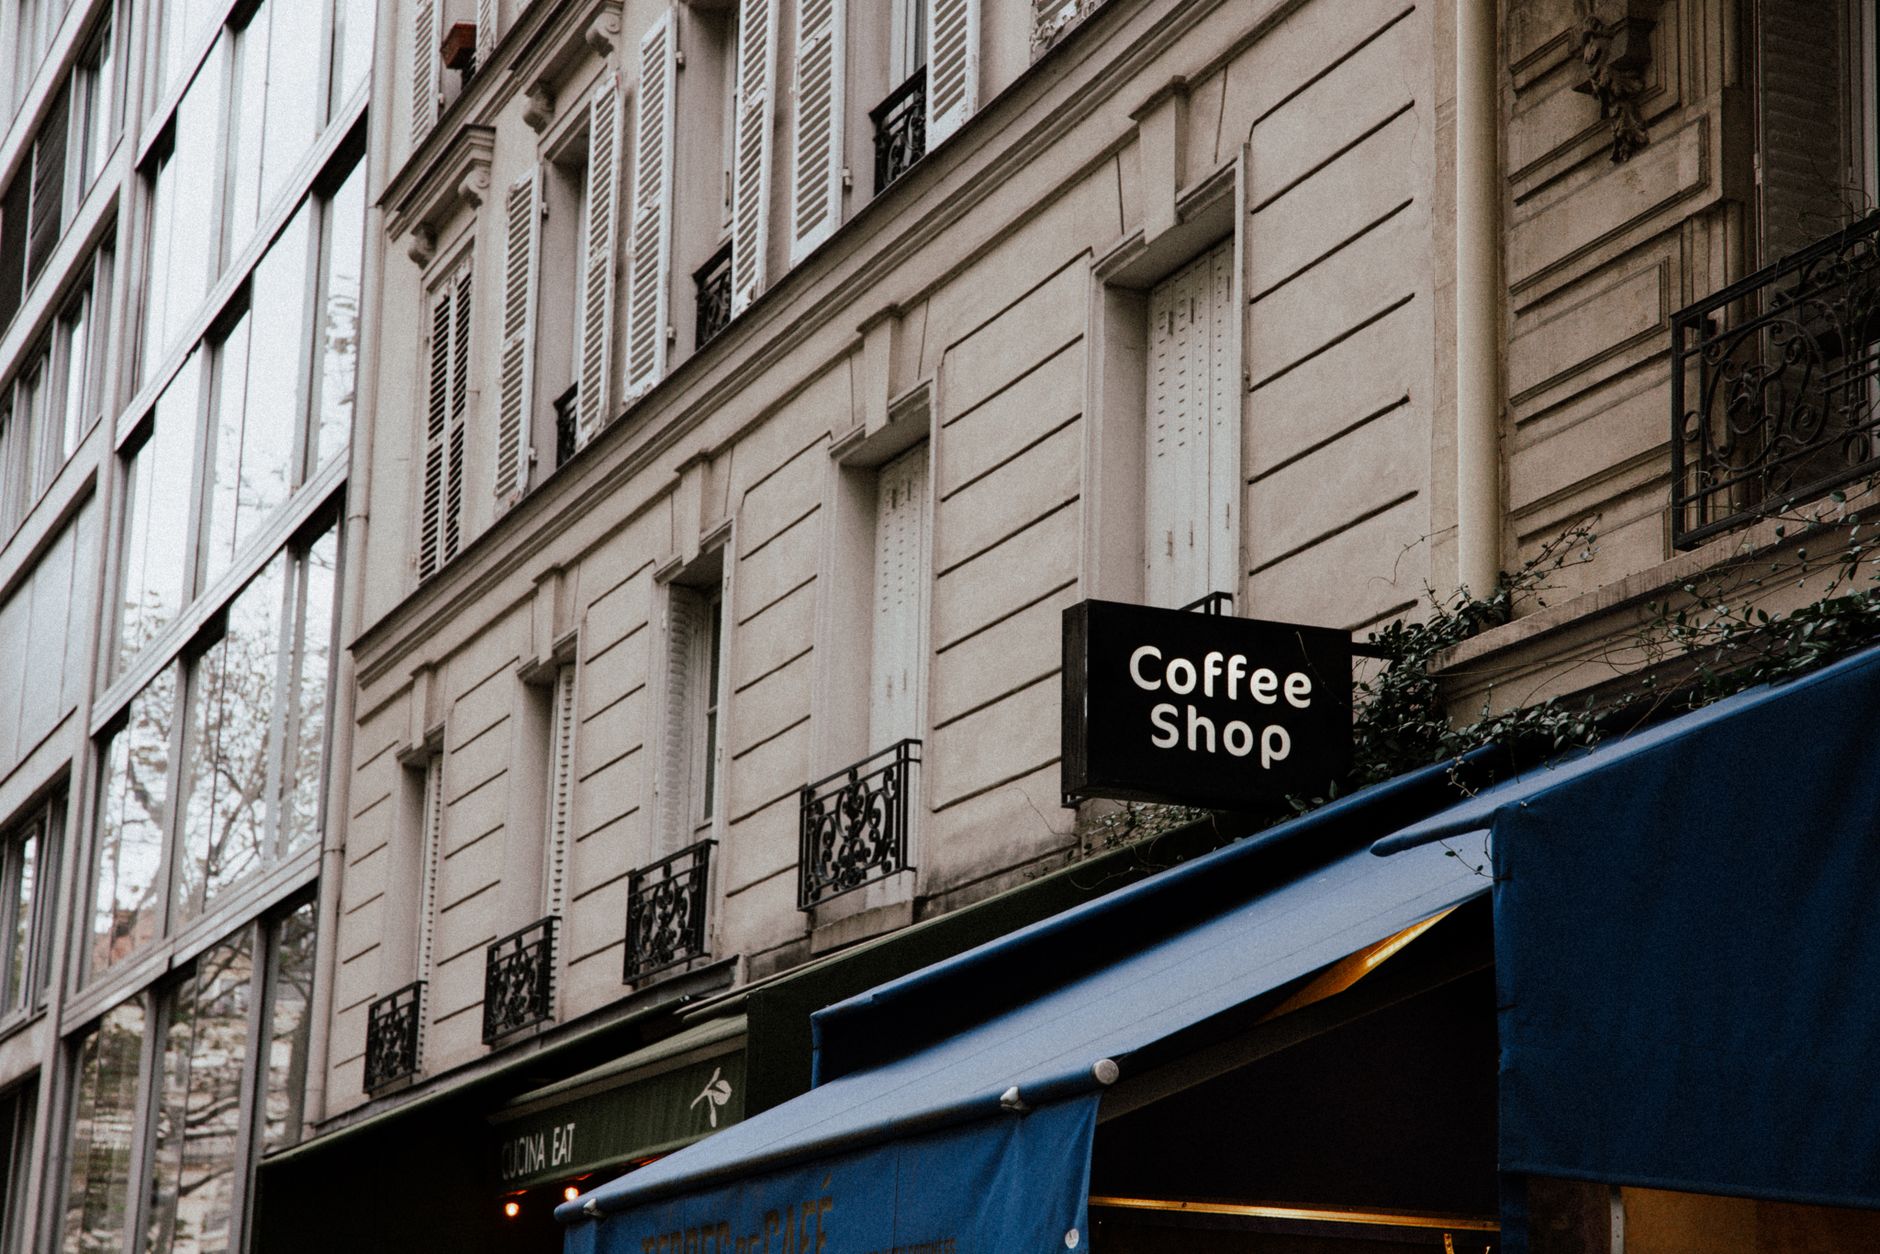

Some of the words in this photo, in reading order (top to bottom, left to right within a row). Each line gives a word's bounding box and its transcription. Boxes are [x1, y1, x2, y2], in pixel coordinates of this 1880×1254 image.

[1129, 645, 1312, 708] Coffee
[1150, 703, 1291, 770] Shop
[501, 1132, 546, 1181] CUCINA
[551, 1122, 576, 1166] EAT
